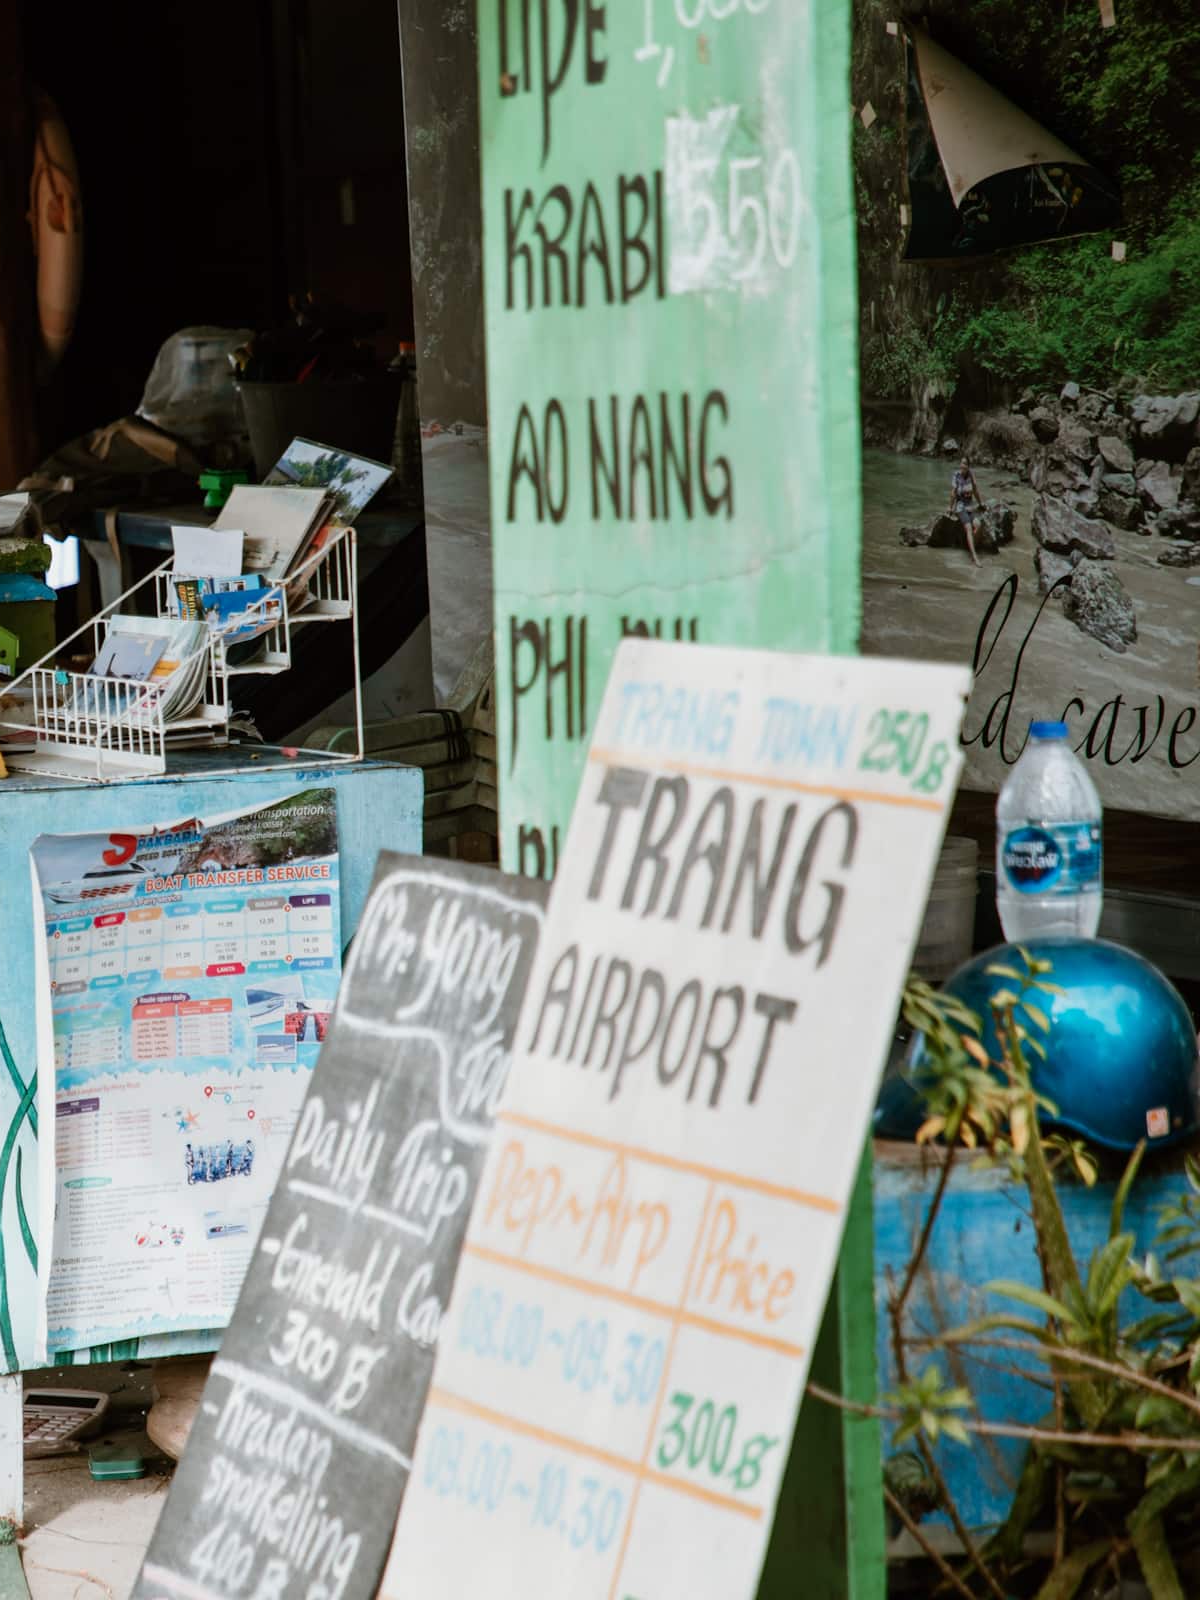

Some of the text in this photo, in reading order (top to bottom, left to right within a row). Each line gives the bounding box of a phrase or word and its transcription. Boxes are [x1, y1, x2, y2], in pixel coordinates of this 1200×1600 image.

[504, 149, 802, 313] KRABI 550
[506, 389, 735, 524] AO NANG
[509, 615, 587, 778] PHI
[611, 680, 742, 760] TRANG
[752, 695, 860, 770] TOWN
[146, 864, 329, 892] BOAT TRANSFER SERVICE
[586, 765, 860, 970] TRANG
[396, 899, 522, 1031] Yong
[526, 942, 798, 1108] AIRPORT
[288, 1079, 385, 1212] Daily
[391, 1122, 469, 1238] Trip
[696, 1198, 797, 1321] Price
[268, 1309, 339, 1381] 300
[189, 1519, 257, 1591] 400
